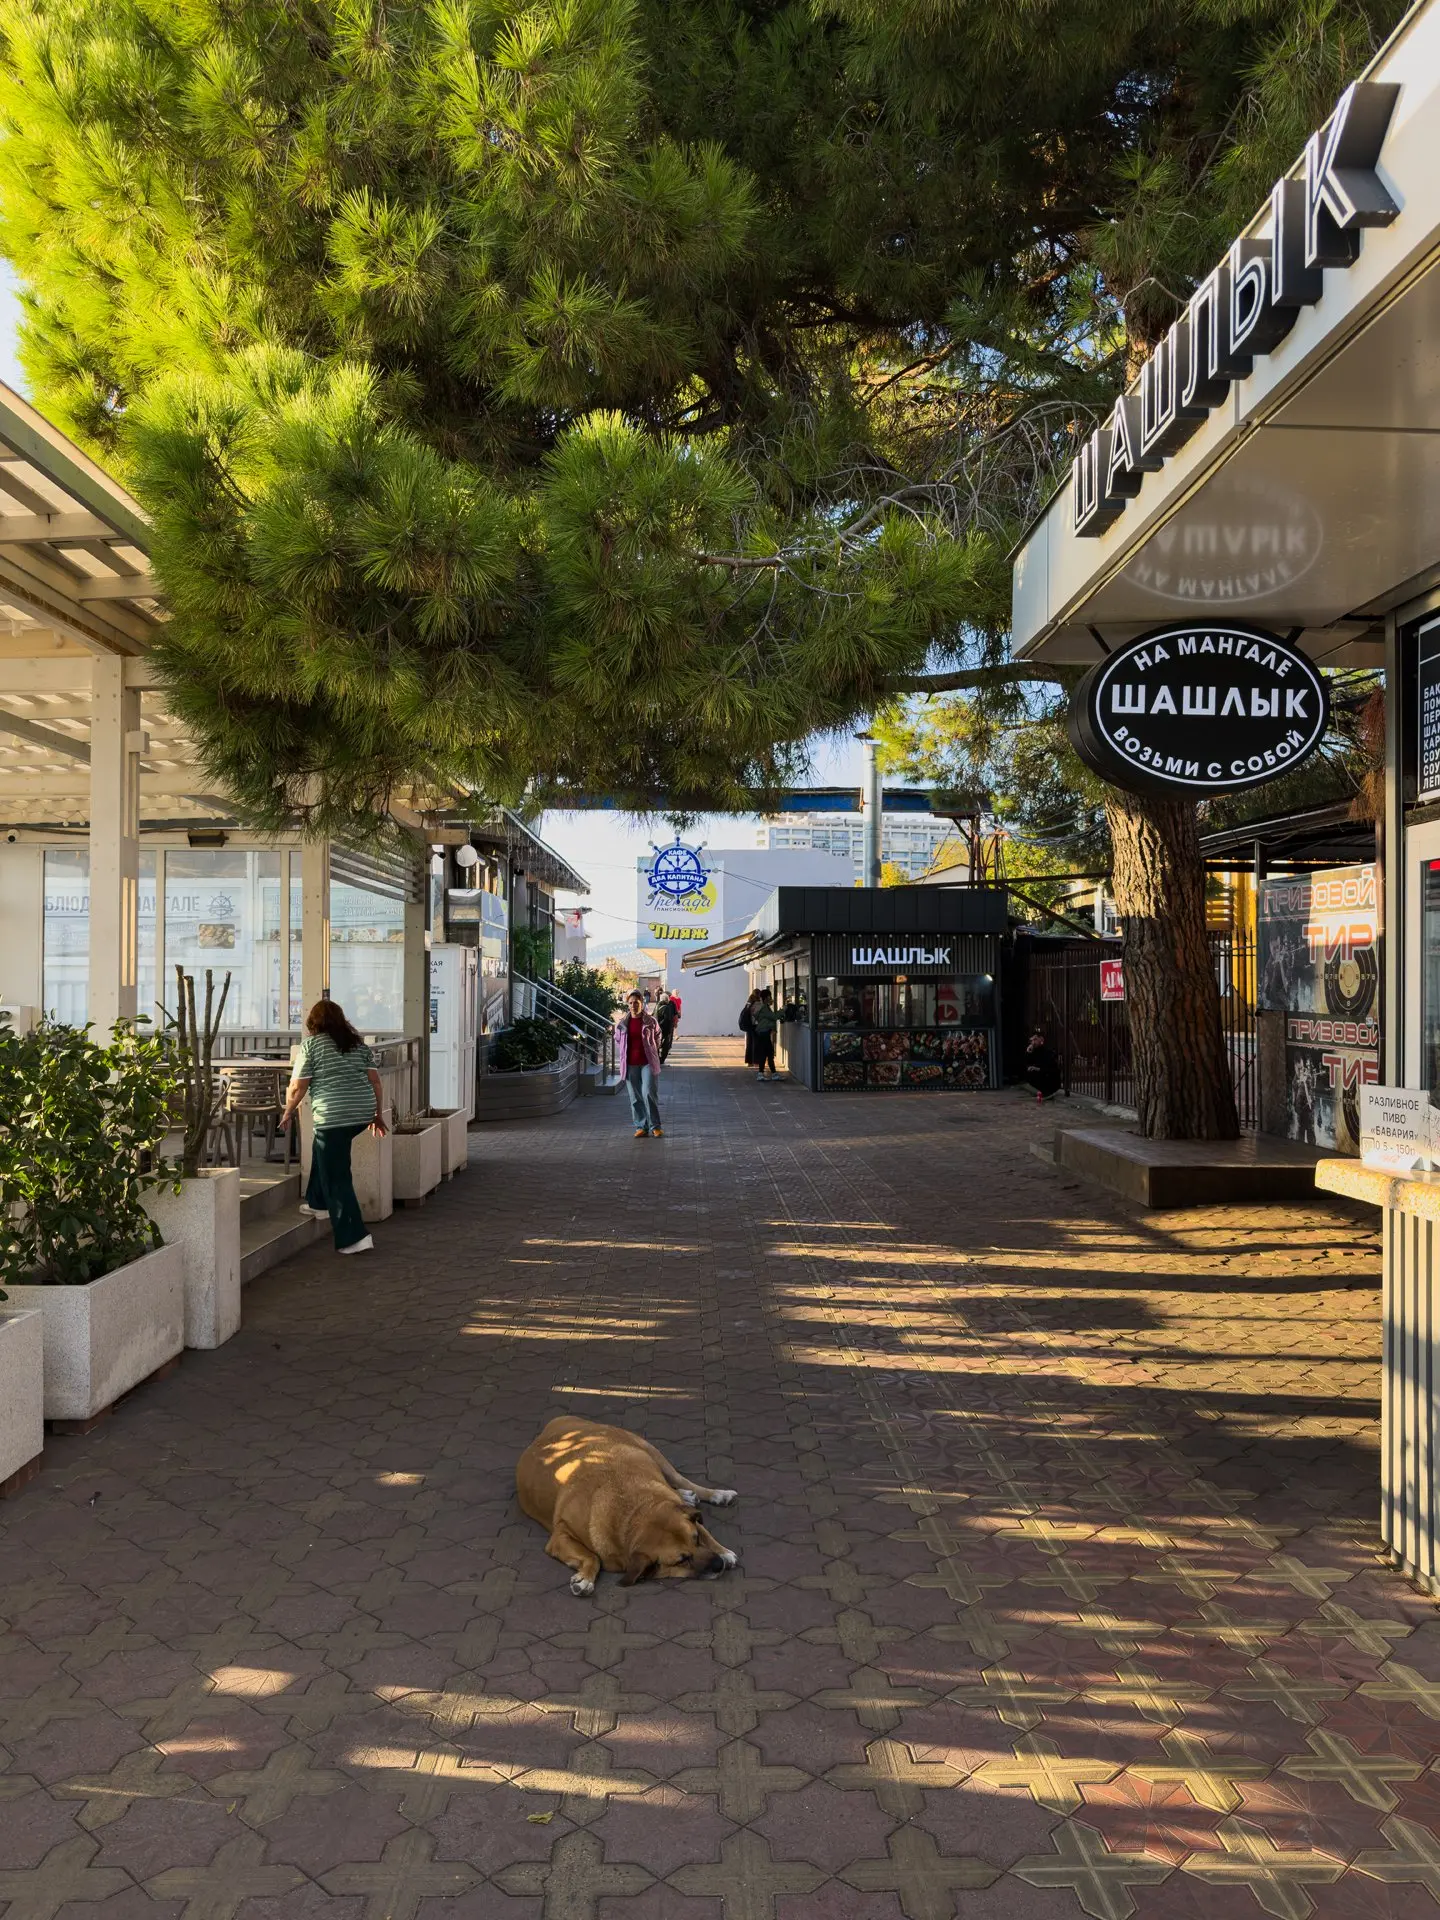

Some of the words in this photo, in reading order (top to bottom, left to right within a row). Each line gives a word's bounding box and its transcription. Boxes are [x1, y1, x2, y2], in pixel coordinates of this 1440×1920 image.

[1073, 82, 1398, 537] ШАШЛЫК
[1133, 645, 1170, 671] НА
[1178, 636, 1292, 678] МАНГАЛЕ
[1111, 684, 1309, 718] ШАШЛЫК
[1113, 725, 1199, 778] ВОЗЬМИ
[1207, 762, 1222, 778] С
[1230, 729, 1305, 776] СОБОЙ
[651, 875, 666, 884] ДВА
[667, 874, 704, 883] КАПИТАНА
[1263, 868, 1376, 914] ПРИЗОВОЙ
[648, 922, 709, 940] Пляж
[1302, 924, 1375, 965] ТИР
[852, 947, 951, 965] ШАШЛЫК
[1368, 1095, 1419, 1111] РАЗЛИВНОЕ
[1382, 1111, 1406, 1124] ПИВО
